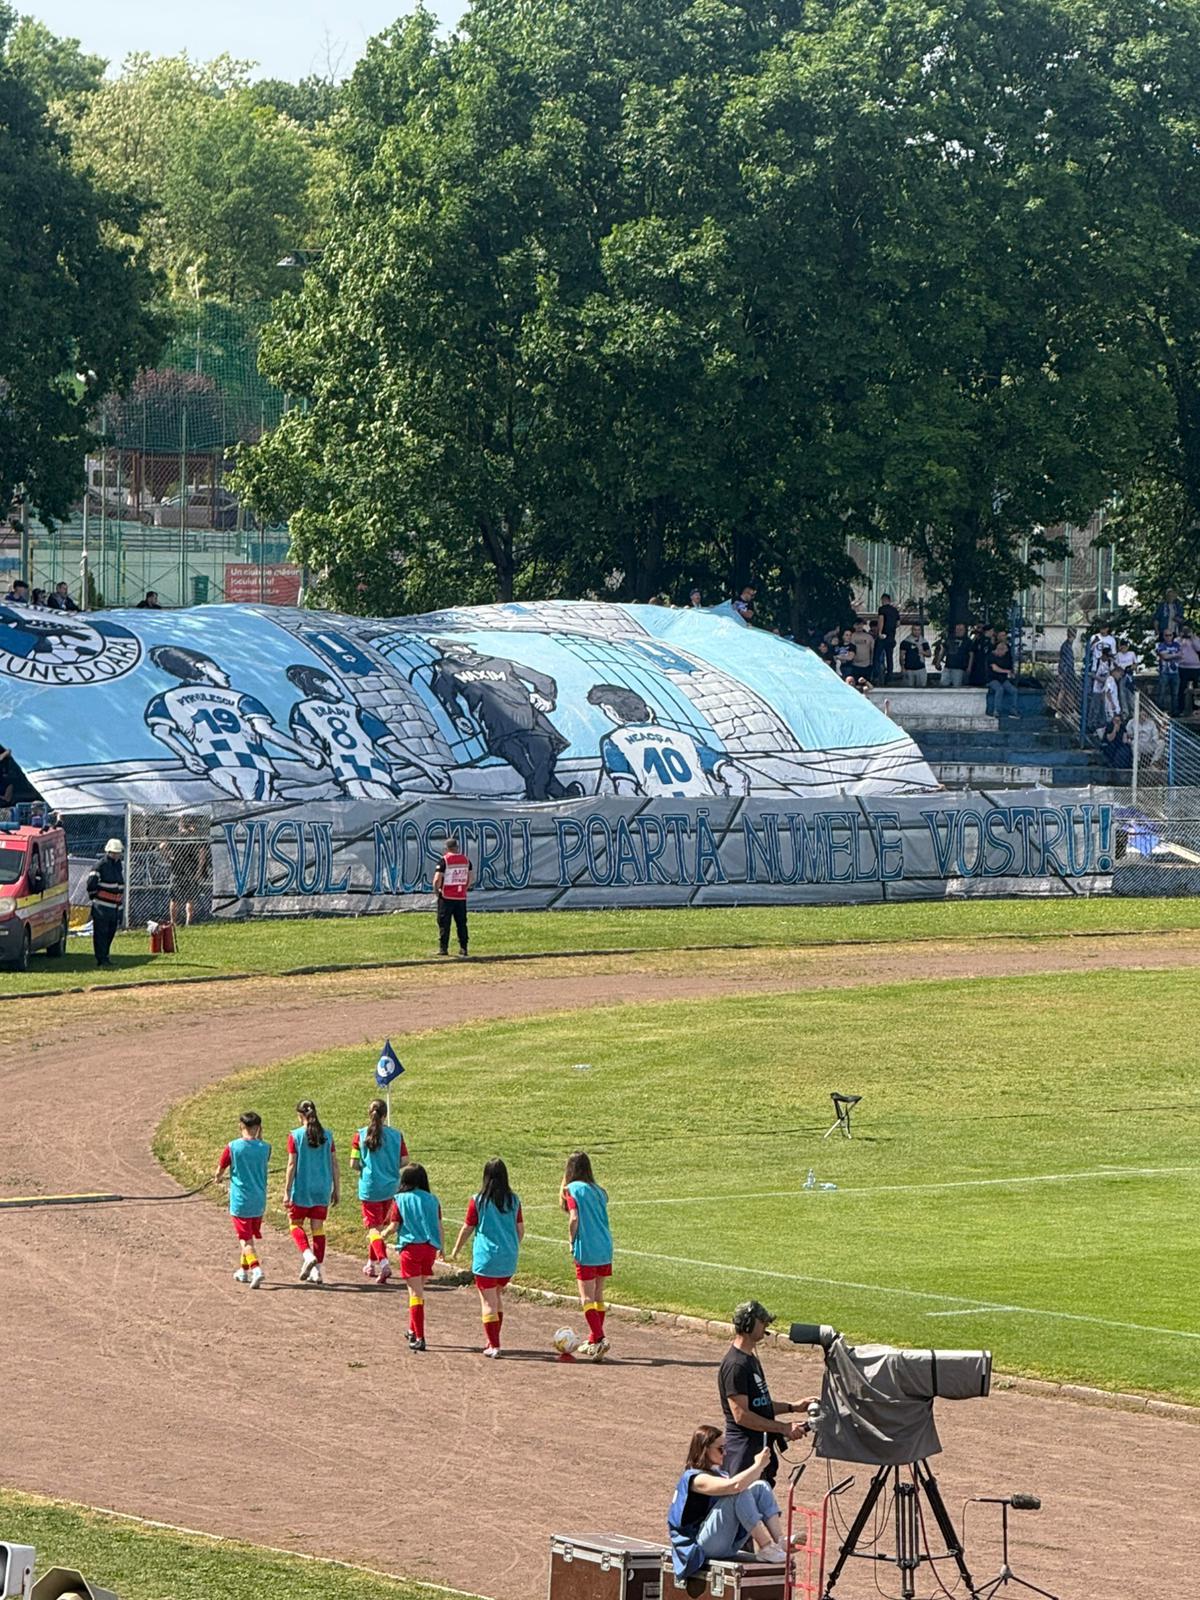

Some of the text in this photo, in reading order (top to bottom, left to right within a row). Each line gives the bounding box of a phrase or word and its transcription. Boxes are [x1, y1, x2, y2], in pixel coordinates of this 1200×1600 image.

[454, 670, 507, 684] MAXIM
[190, 708, 241, 734] 19
[327, 716, 357, 750] 8
[643, 746, 693, 785] 10
[222, 803, 1116, 899] VISUL NOSTRU POARTĂ NUMELE VOSTRU!
